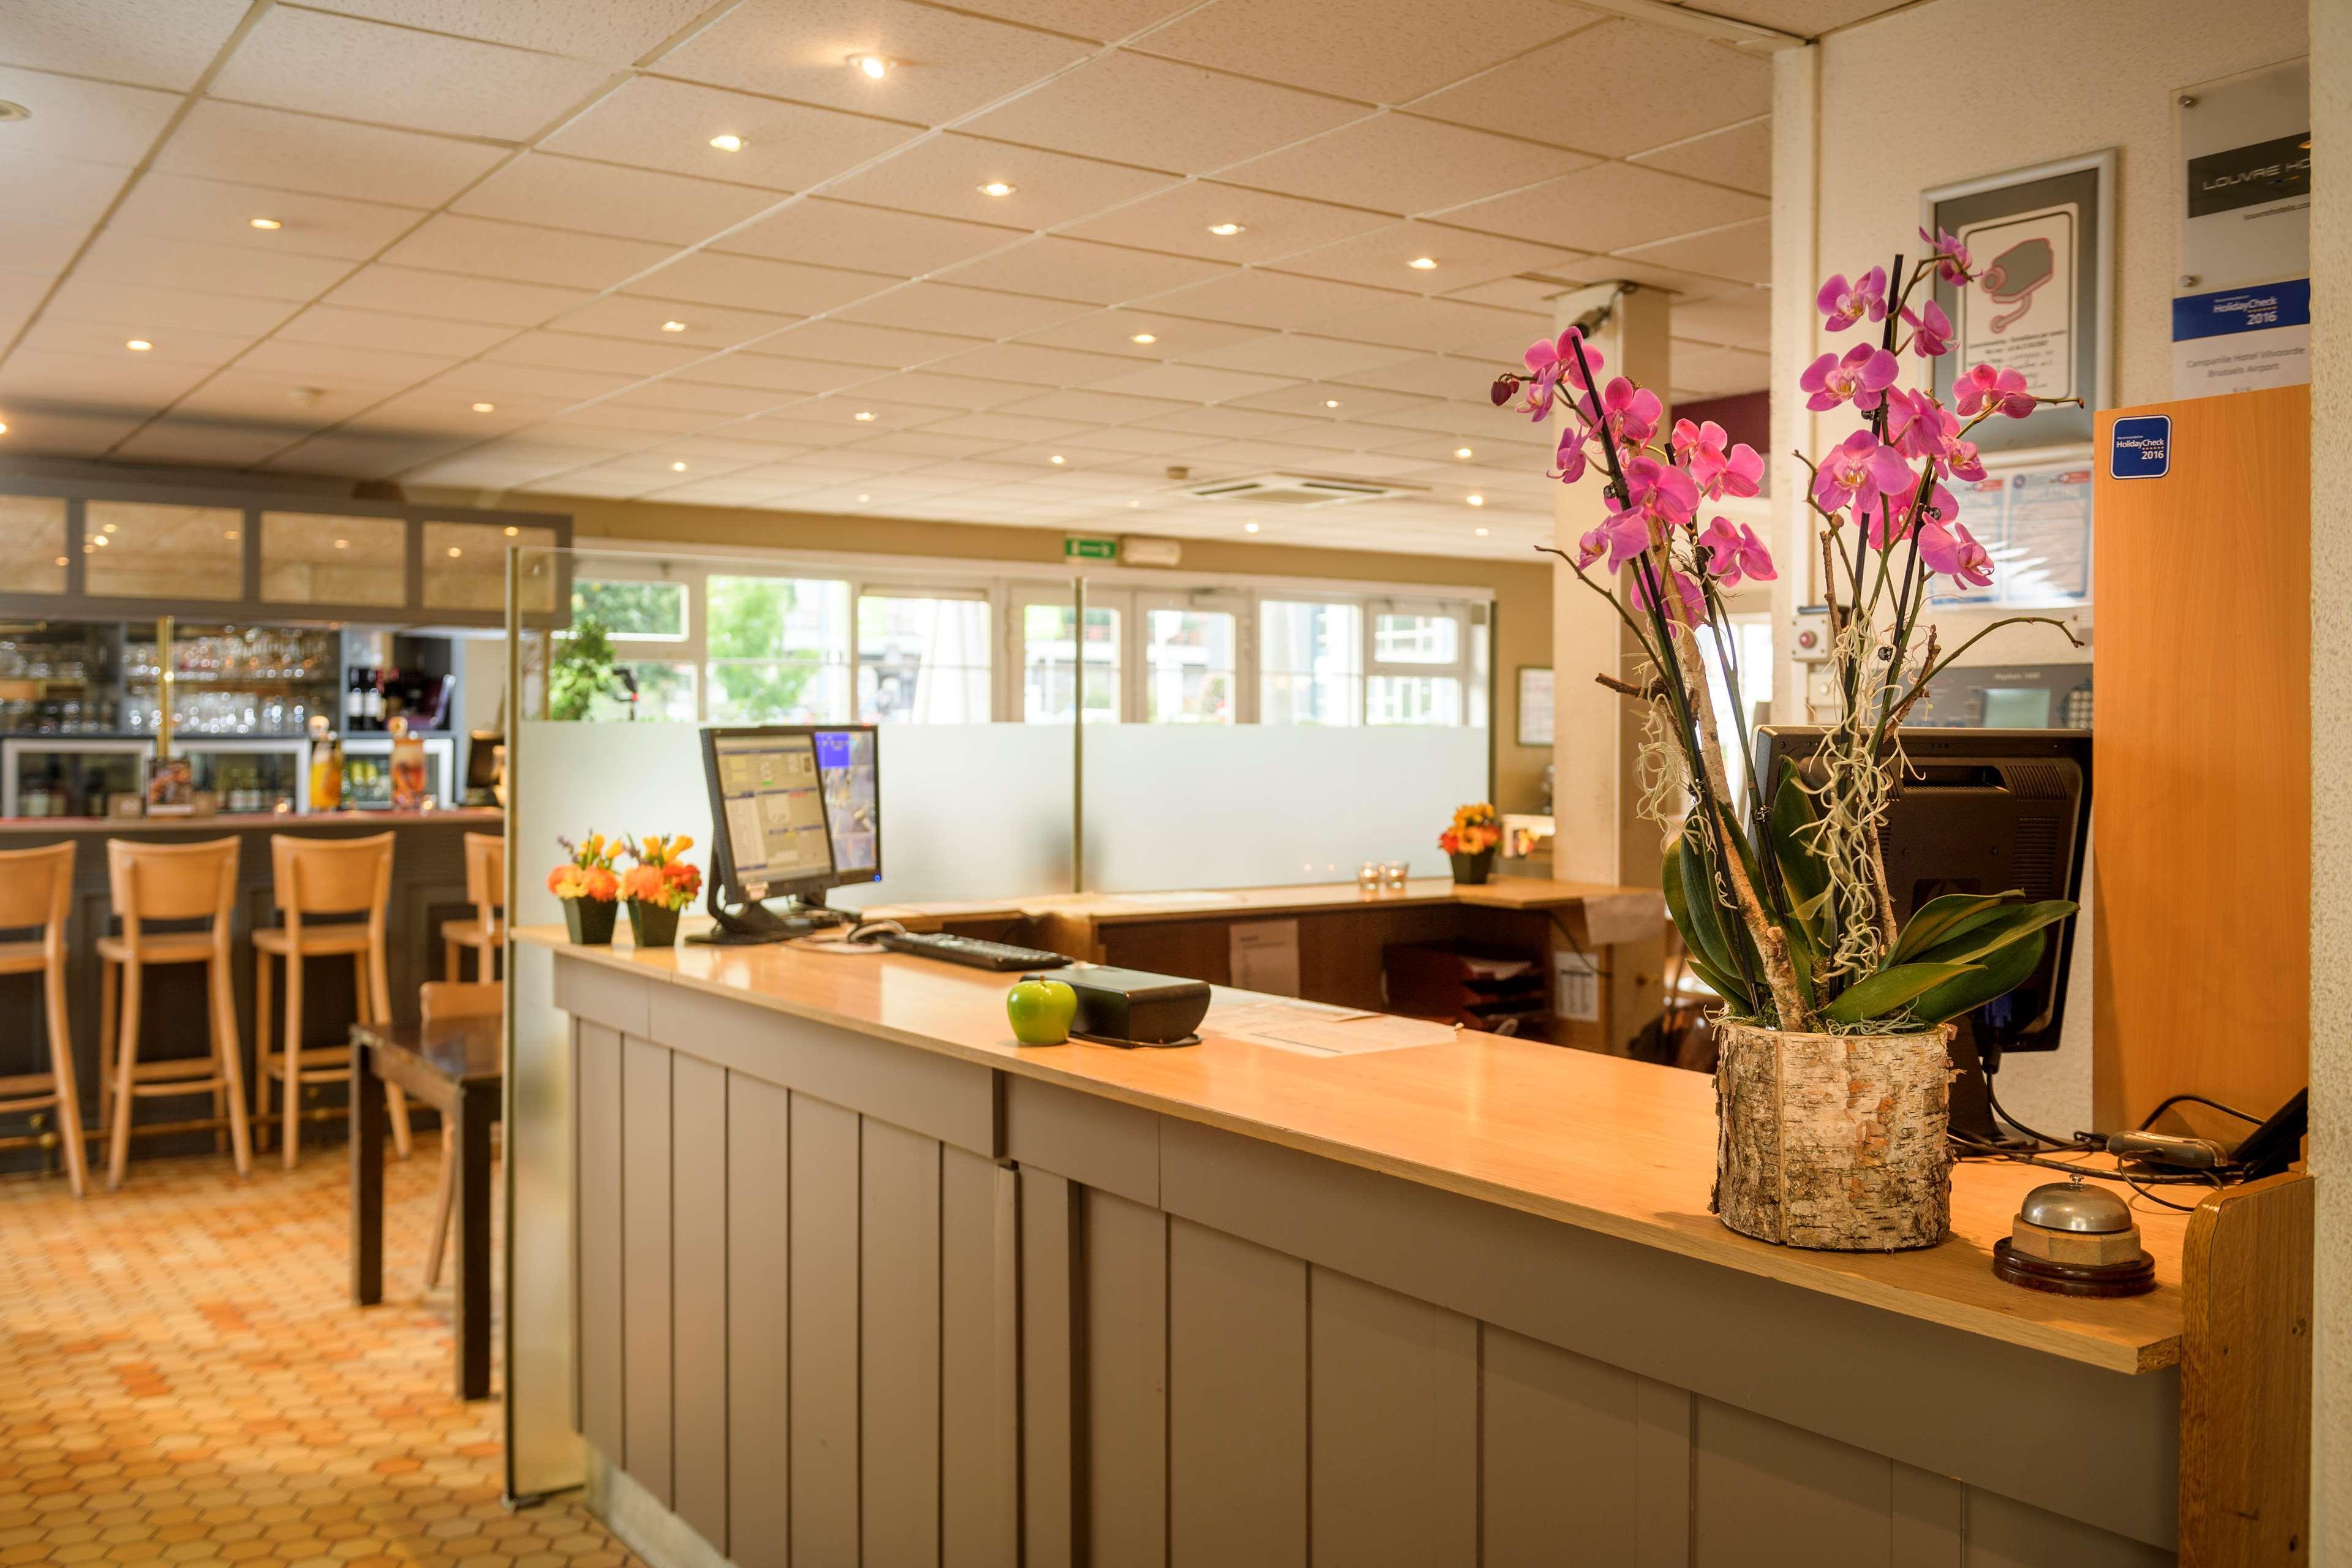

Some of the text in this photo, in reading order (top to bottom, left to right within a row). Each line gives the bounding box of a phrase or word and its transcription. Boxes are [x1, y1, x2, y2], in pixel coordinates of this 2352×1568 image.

[2203, 164, 2281, 190] LOUVRE
[2212, 297, 2277, 313] HolidayCheck
[2246, 311, 2277, 325] 2016
[2187, 347, 2305, 368] Campanile Hotel Vilvoorde
[2207, 363, 2280, 377] Brussels Airport
[2116, 439, 2164, 449] HolidayCheck
[2141, 450, 2164, 459] 2016
